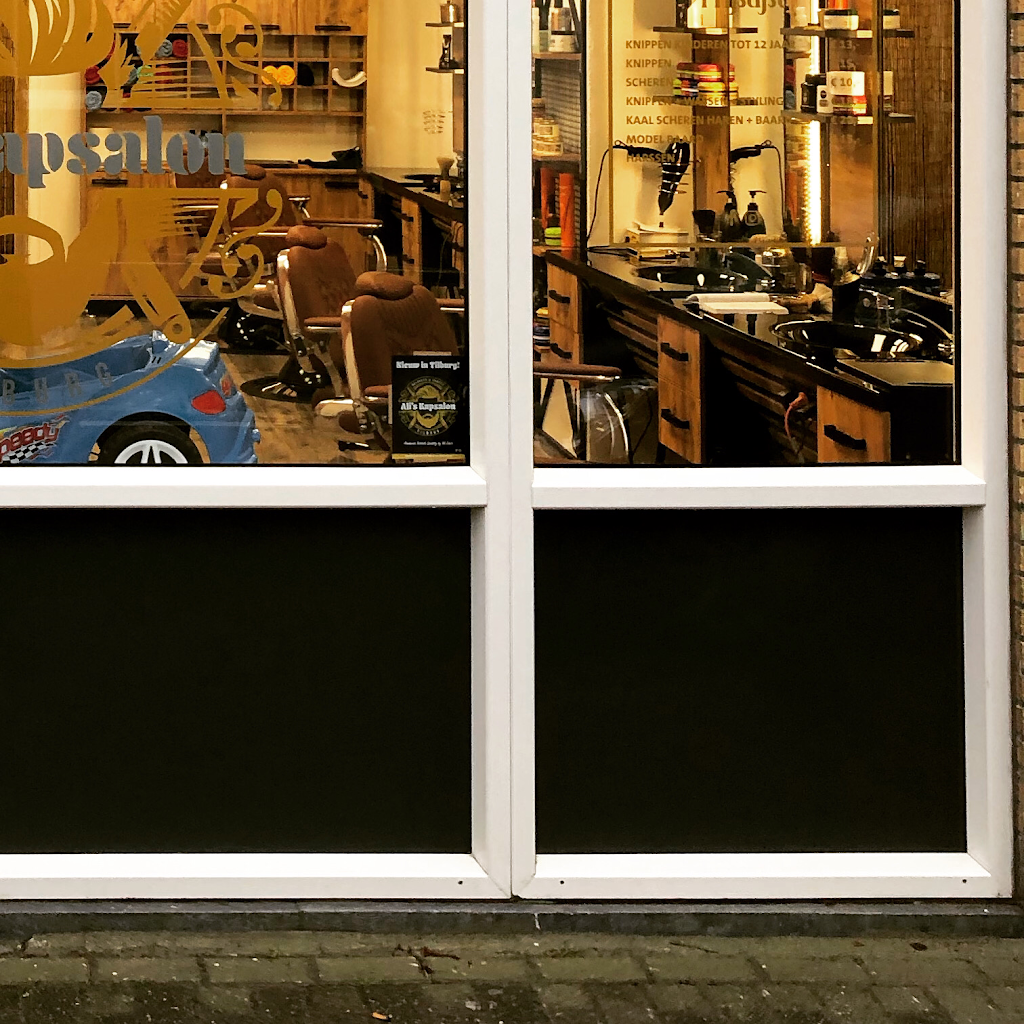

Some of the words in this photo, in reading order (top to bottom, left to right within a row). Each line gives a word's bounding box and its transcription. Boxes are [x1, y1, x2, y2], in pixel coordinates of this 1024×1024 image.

[625, 39, 671, 49] KNIPPEN
[730, 39, 751, 49] TOT
[754, 39, 766, 49] 12
[625, 59, 671, 68] KNIPPEN
[626, 78, 674, 87] SCHEREN
[626, 115, 653, 125] KAAL
[656, 115, 705, 125] SCHEREN
[626, 134, 665, 144] MODEL
[421, 361, 429, 369] in
[419, 402, 456, 412] Kapsalon
